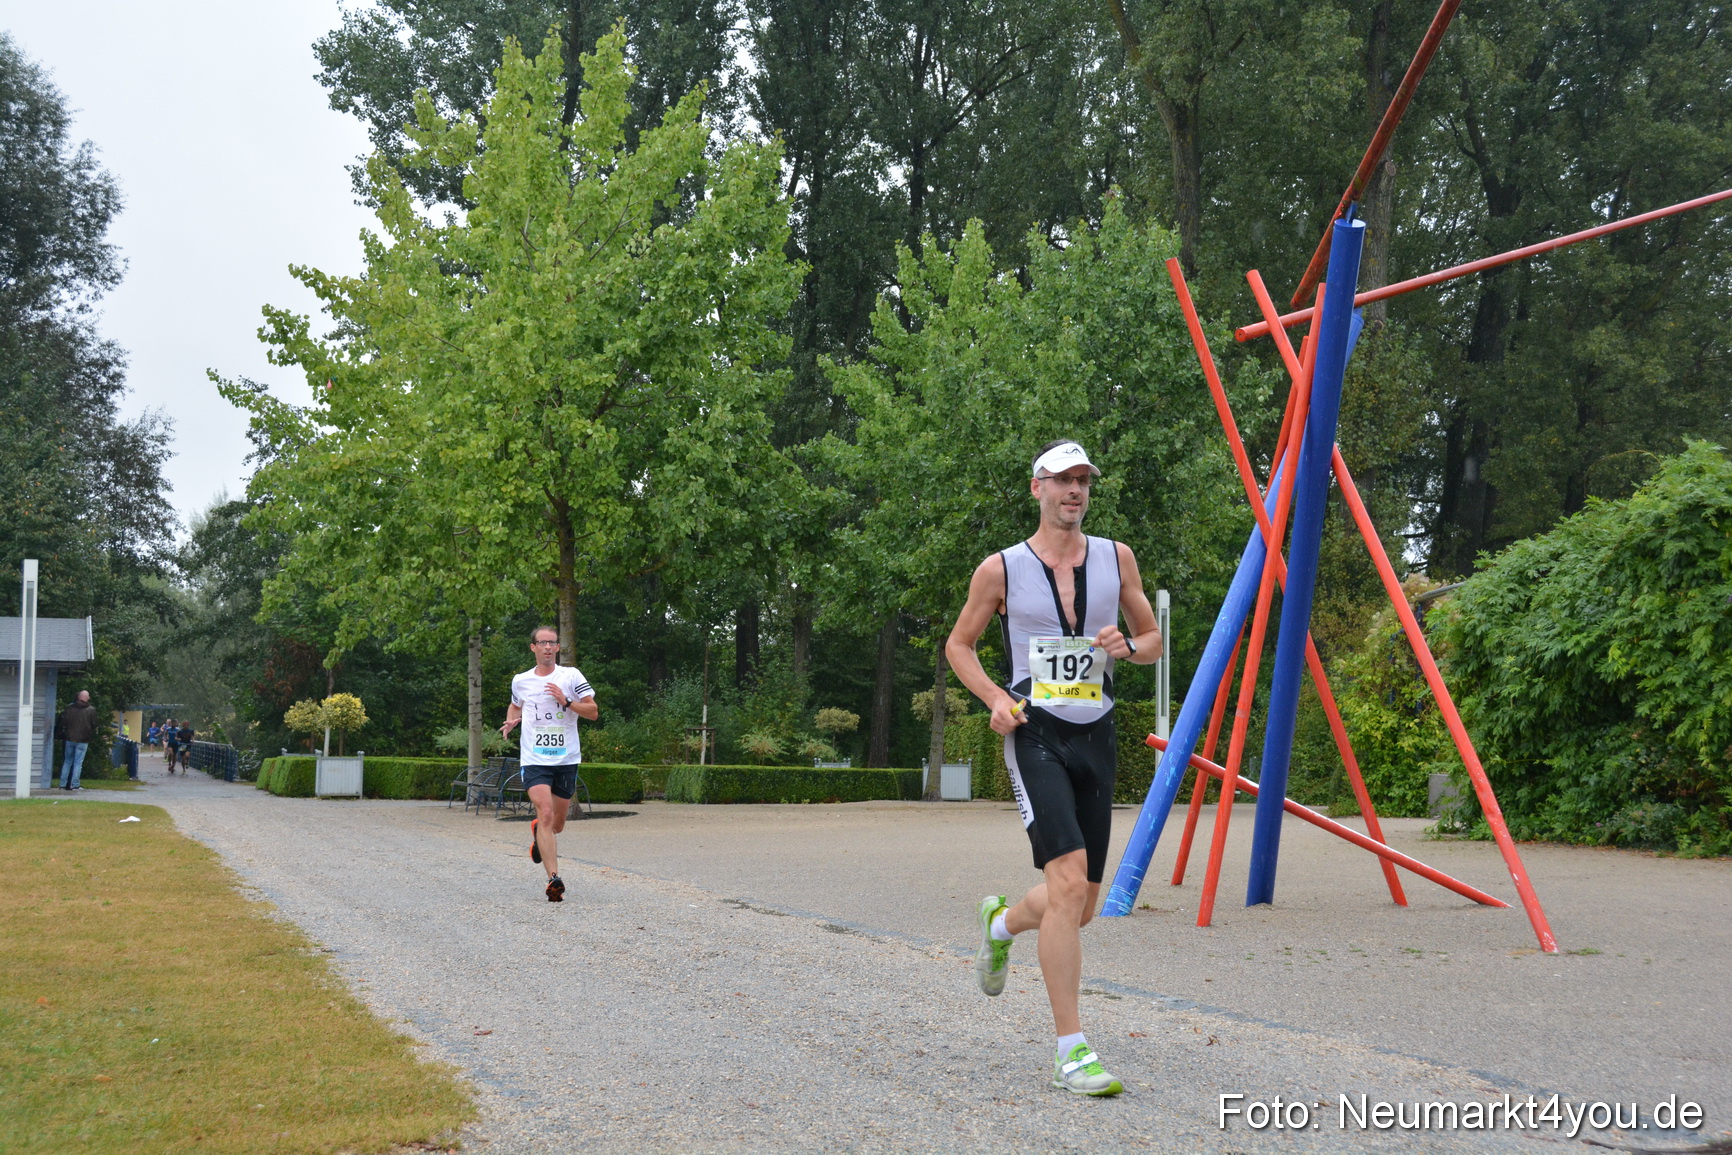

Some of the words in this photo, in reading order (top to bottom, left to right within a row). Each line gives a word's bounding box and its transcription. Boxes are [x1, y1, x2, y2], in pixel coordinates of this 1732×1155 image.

[1046, 654, 1093, 681] 192
[1058, 686, 1080, 696] Lars
[535, 733, 565, 747] 2359
[1009, 768, 1028, 820] sailfish
